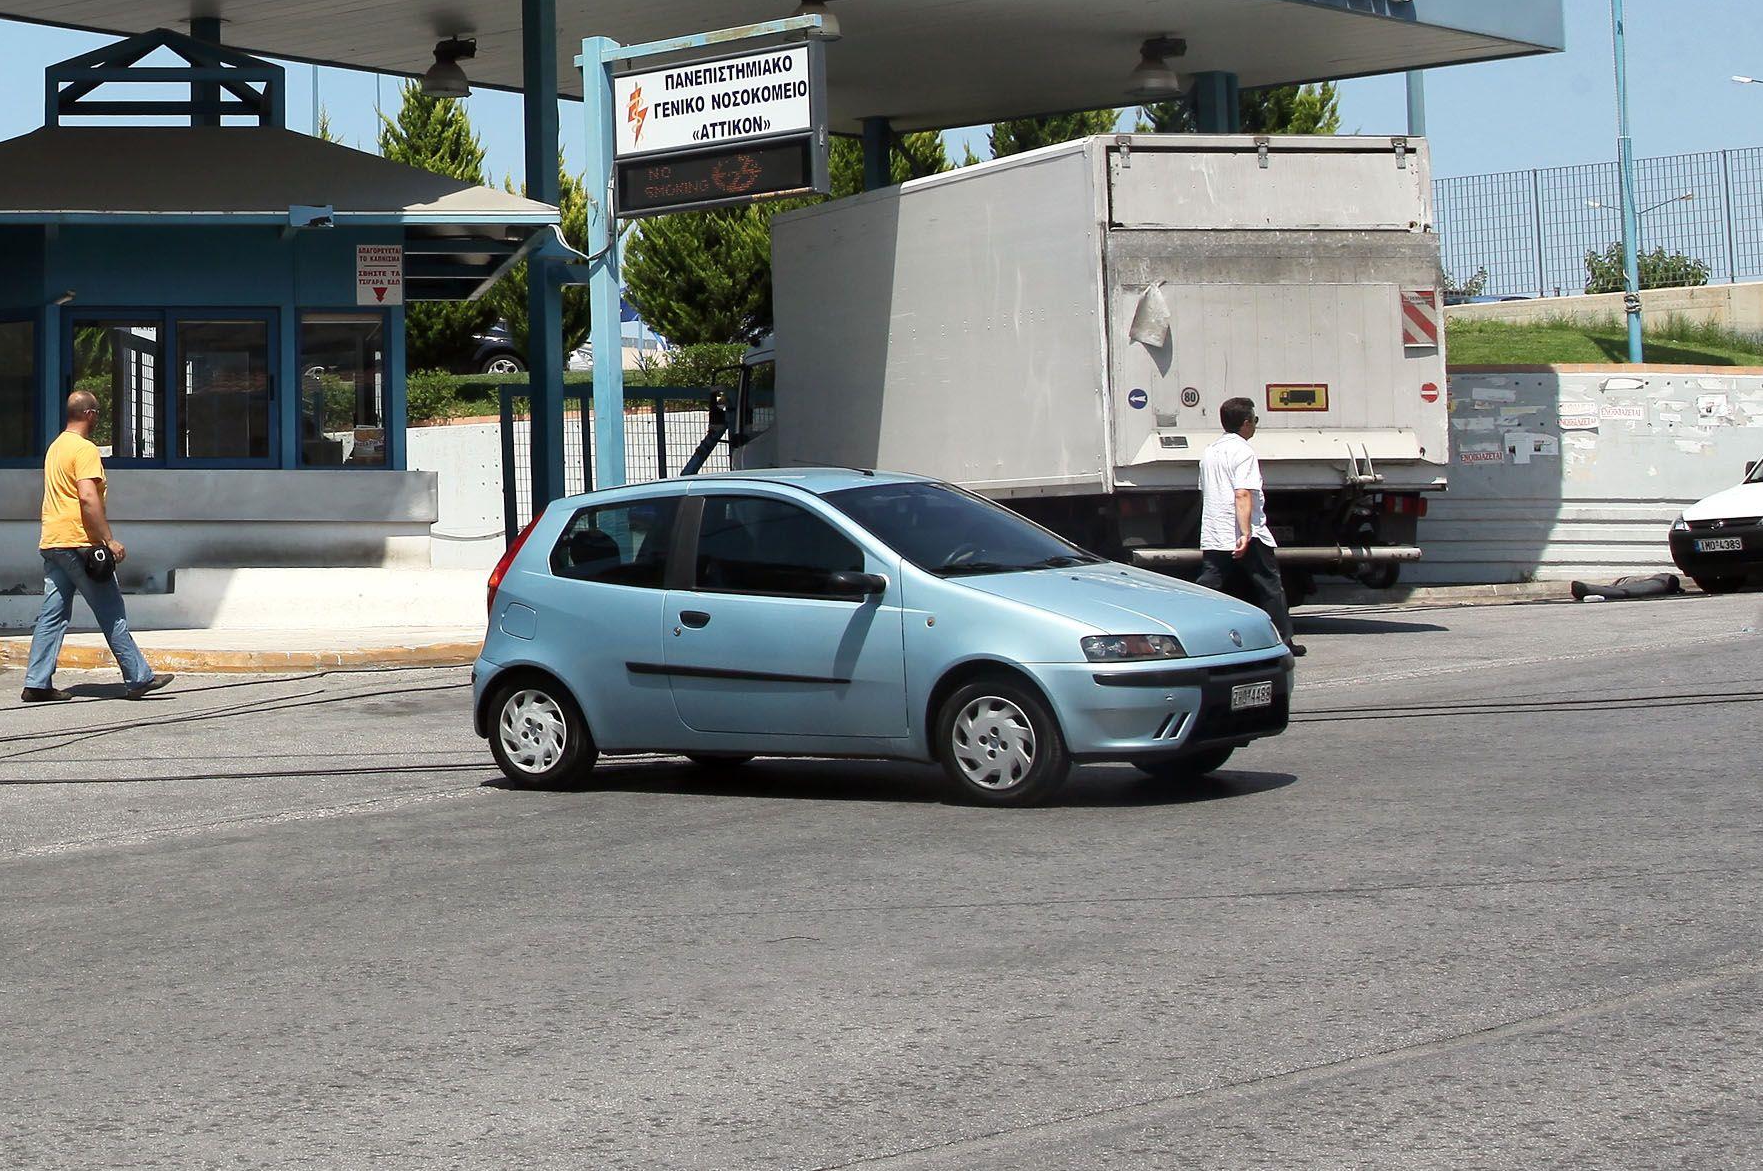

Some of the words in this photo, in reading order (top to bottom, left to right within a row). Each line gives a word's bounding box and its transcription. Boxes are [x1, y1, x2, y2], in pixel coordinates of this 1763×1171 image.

[665, 55, 792, 91] ΠΑΝΕΠΙΣΤΗΜΙΑΚΟ
[654, 96, 705, 119] ΓΕΝΙΚΟ
[711, 80, 807, 110] ΝΟΣΟΚΟΜΕΙΟ
[692, 115, 771, 141] «ΑΤΤΙΚΟΝ»
[1184, 391, 1196, 403] 80
